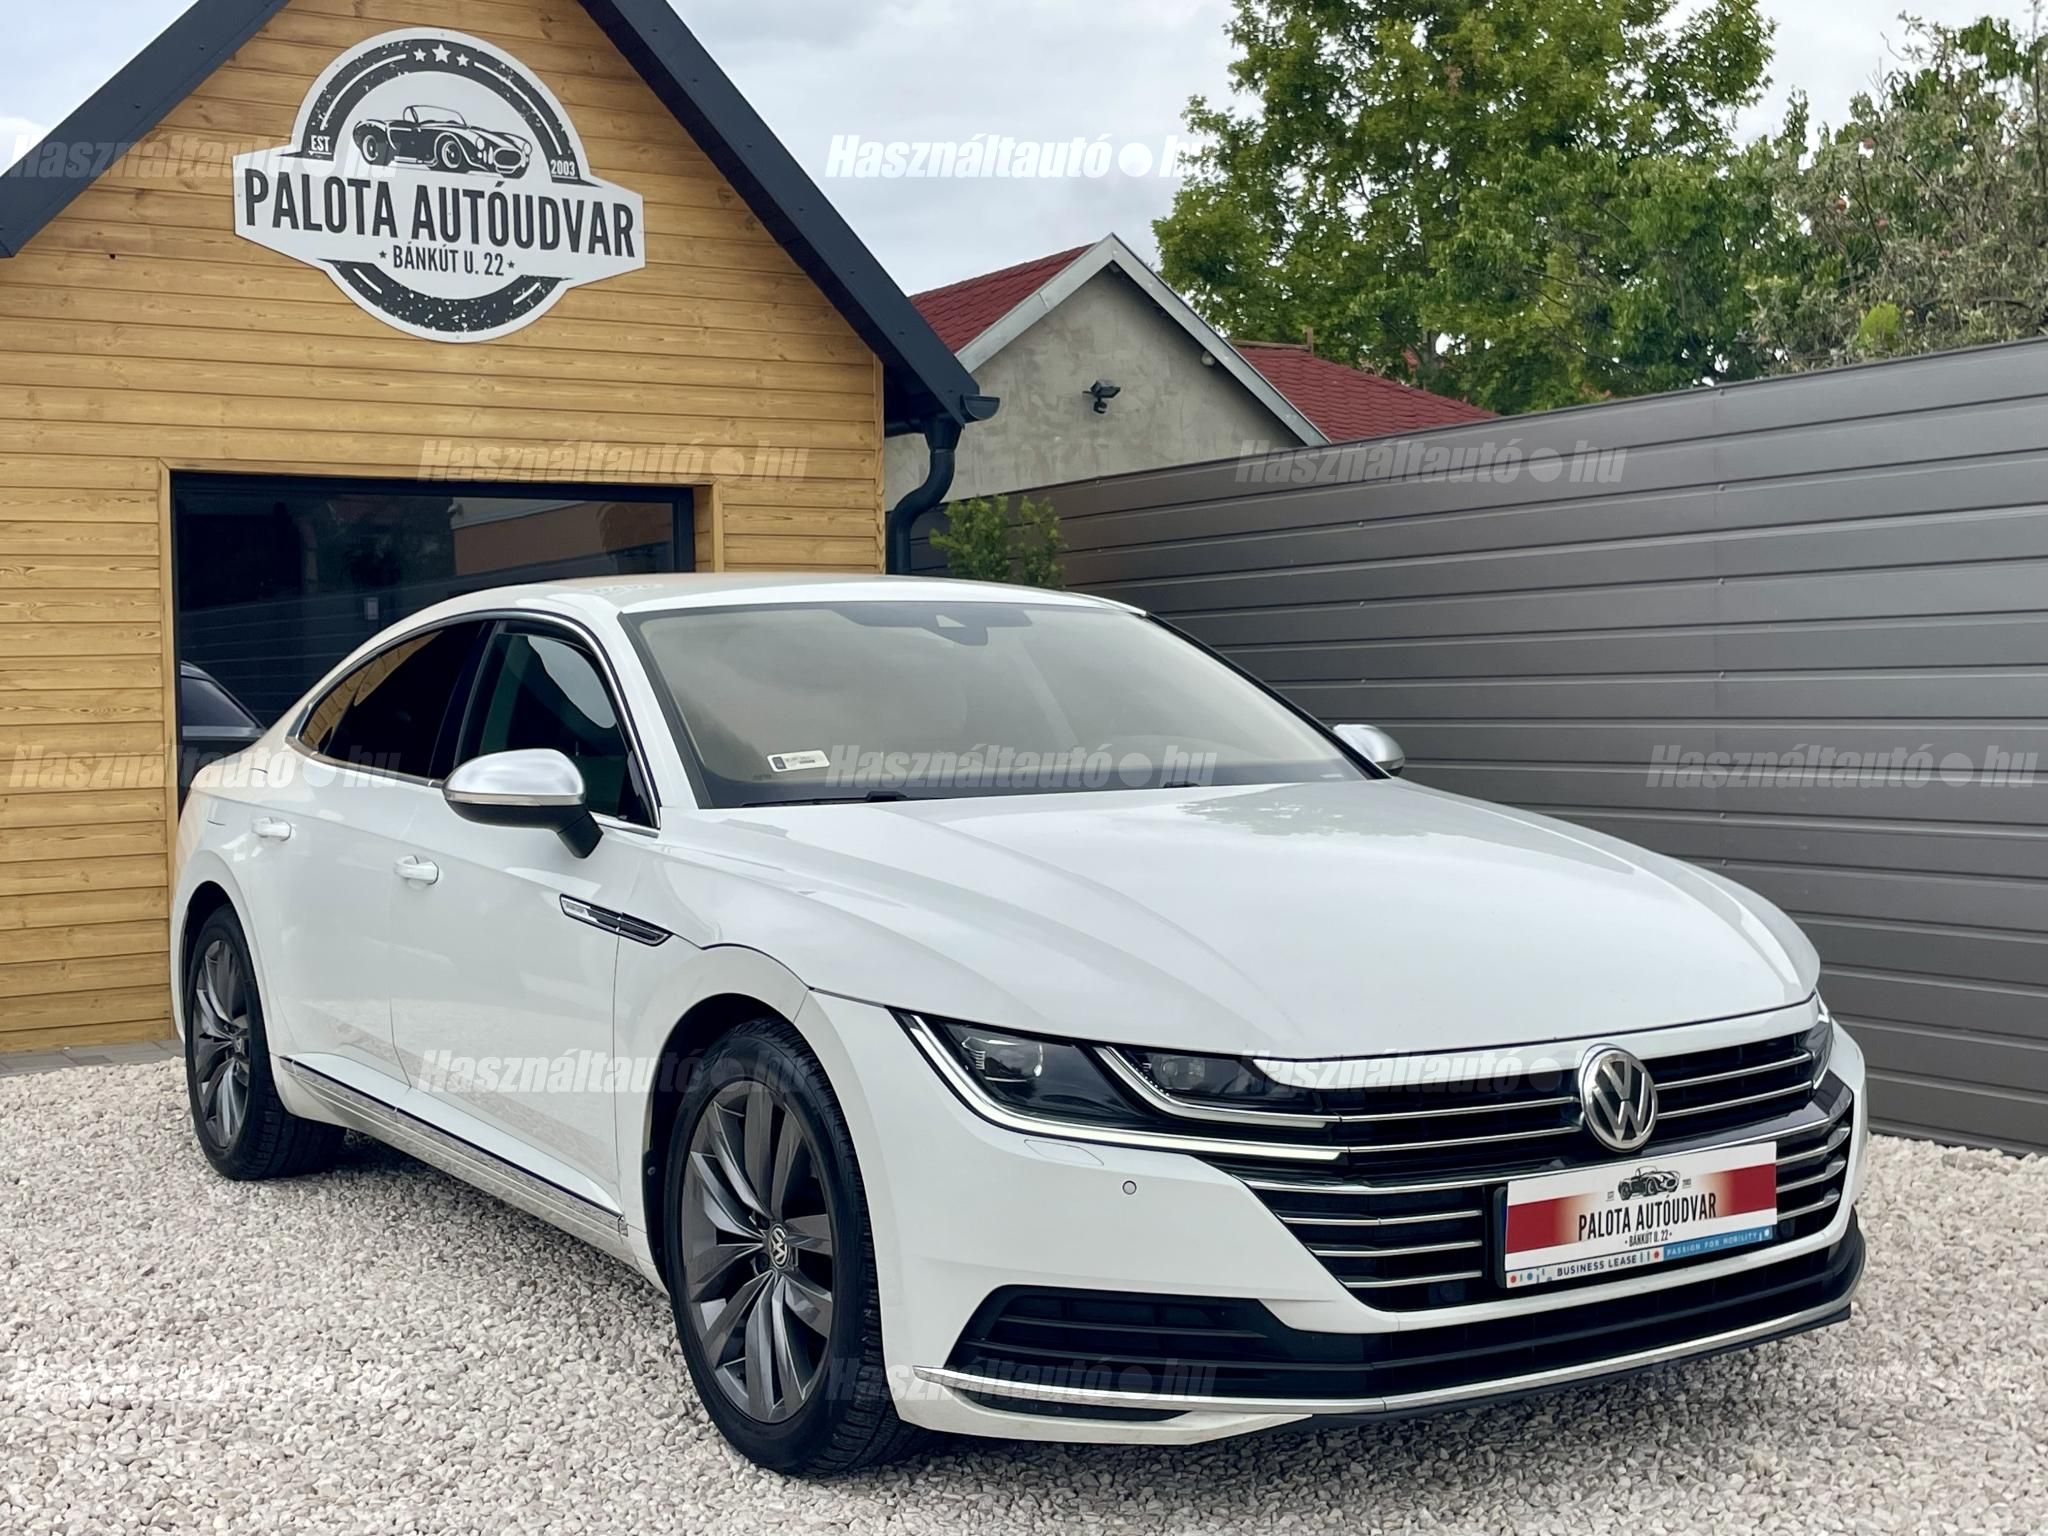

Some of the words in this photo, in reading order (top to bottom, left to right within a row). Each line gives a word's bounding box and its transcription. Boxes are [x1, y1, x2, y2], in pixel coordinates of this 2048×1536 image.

[311, 135, 331, 153] EST
[550, 160, 576, 176] 2003
[244, 168, 398, 238] PALOTA
[411, 180, 635, 258] AUTÓUDVAR
[393, 241, 459, 274] BÁNKÚT
[463, 250, 480, 274] U.
[483, 253, 504, 276] 22
[1578, 1206, 1631, 1242] PALOTA
[1636, 1193, 1717, 1231] AUTÓUDVAR
[1704, 1238, 1720, 1249] FOR
[1557, 1260, 1605, 1277] BUSINESS
[1608, 1254, 1637, 1268] LEASE
